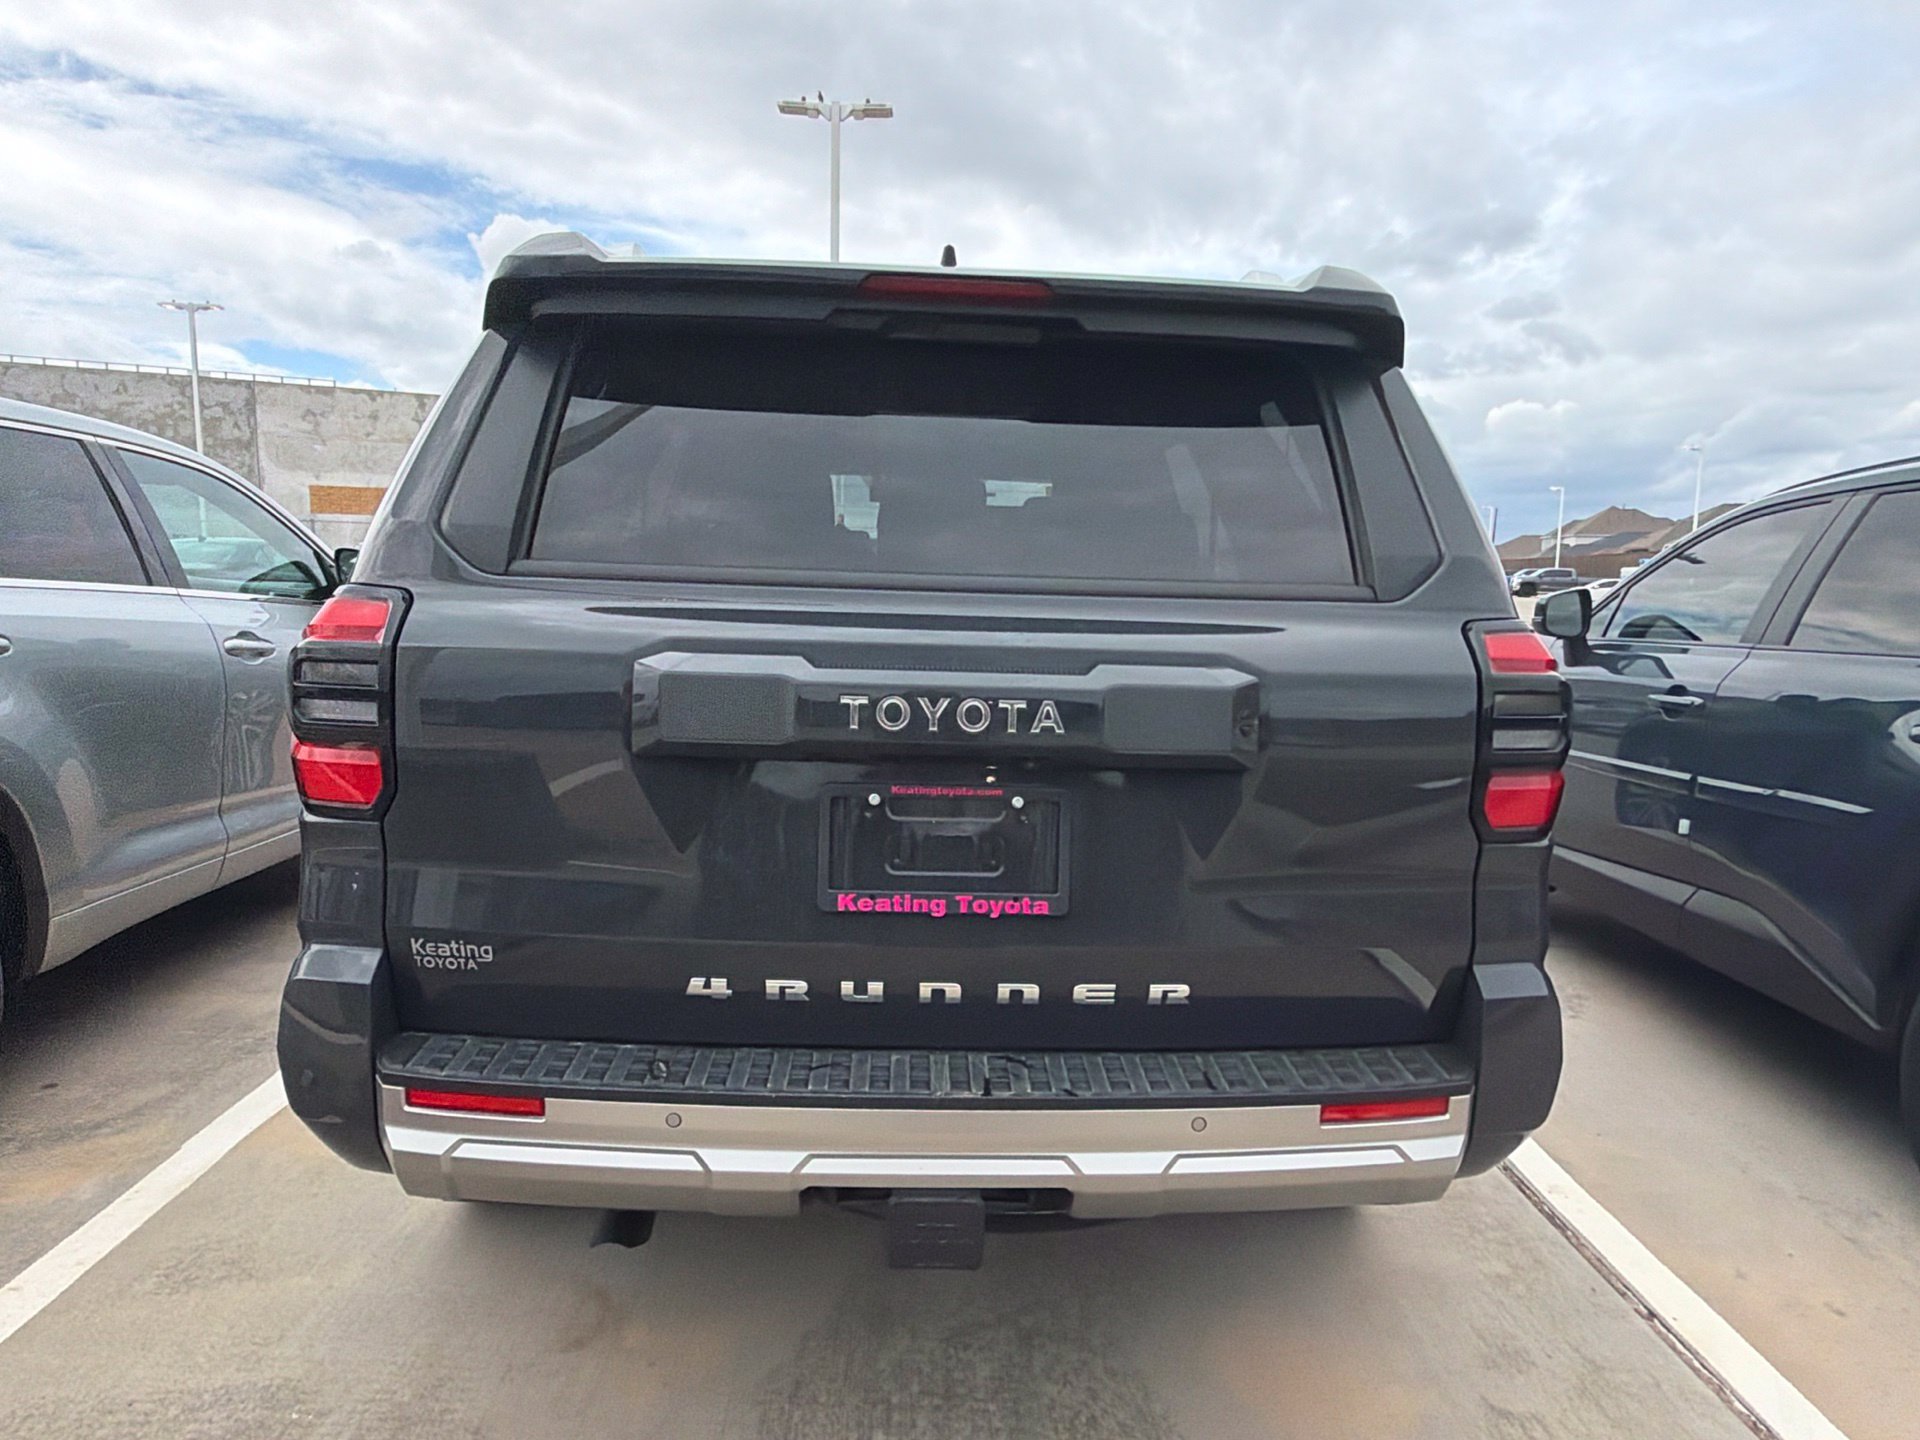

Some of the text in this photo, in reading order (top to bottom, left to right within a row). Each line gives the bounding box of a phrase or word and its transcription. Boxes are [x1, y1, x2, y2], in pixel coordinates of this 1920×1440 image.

[840, 695, 1065, 734] TOYOTA
[837, 893, 1049, 918] Keating Toyota
[410, 937, 493, 962] Keating
[413, 955, 478, 970] TOYOTA
